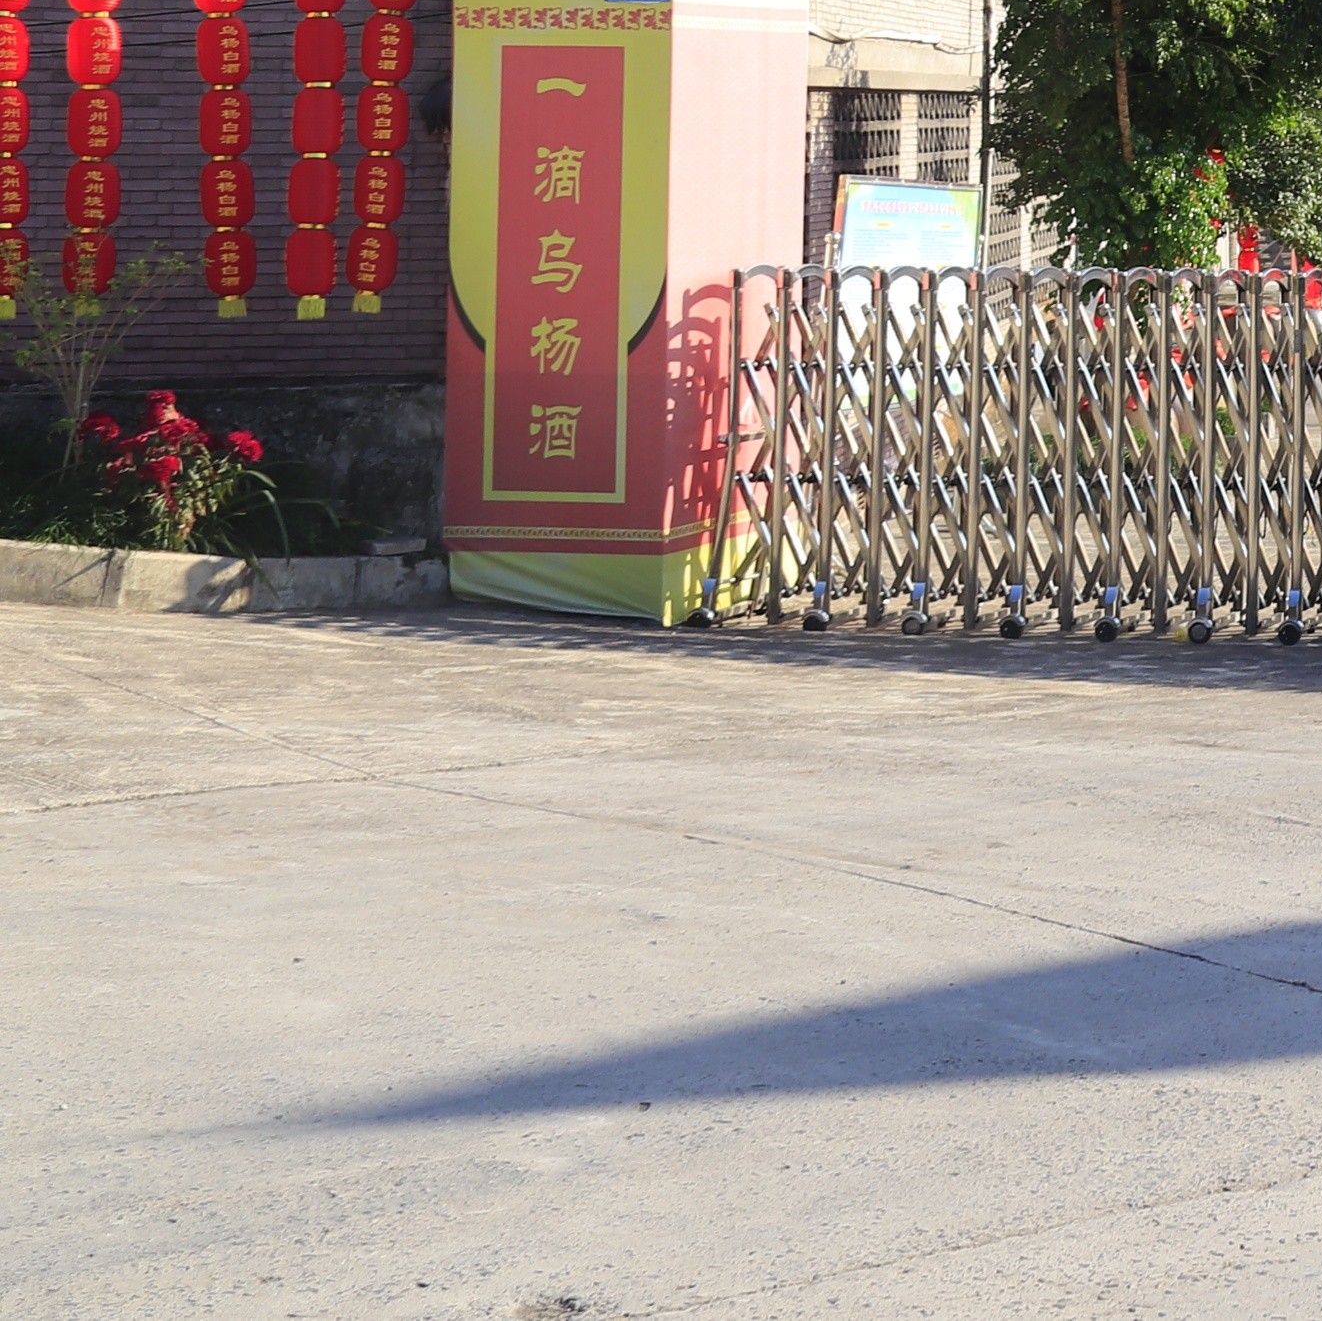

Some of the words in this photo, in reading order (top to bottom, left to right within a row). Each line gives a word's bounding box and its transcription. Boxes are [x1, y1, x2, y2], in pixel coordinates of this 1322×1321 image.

[219, 25, 241, 74] 乌杨白酒
[377, 22, 400, 71] 乌杨白酒
[219, 97, 241, 145] 乌杨白酒
[372, 92, 393, 140] 乌杨白酒
[215, 169, 238, 217] 乌杨白酒
[365, 166, 388, 215] 乌杨白酒
[219, 241, 241, 287] 乌杨白酒
[357, 237, 381, 283] 乌杨白酒
[528, 77, 587, 461] 一滴乌杨酒
